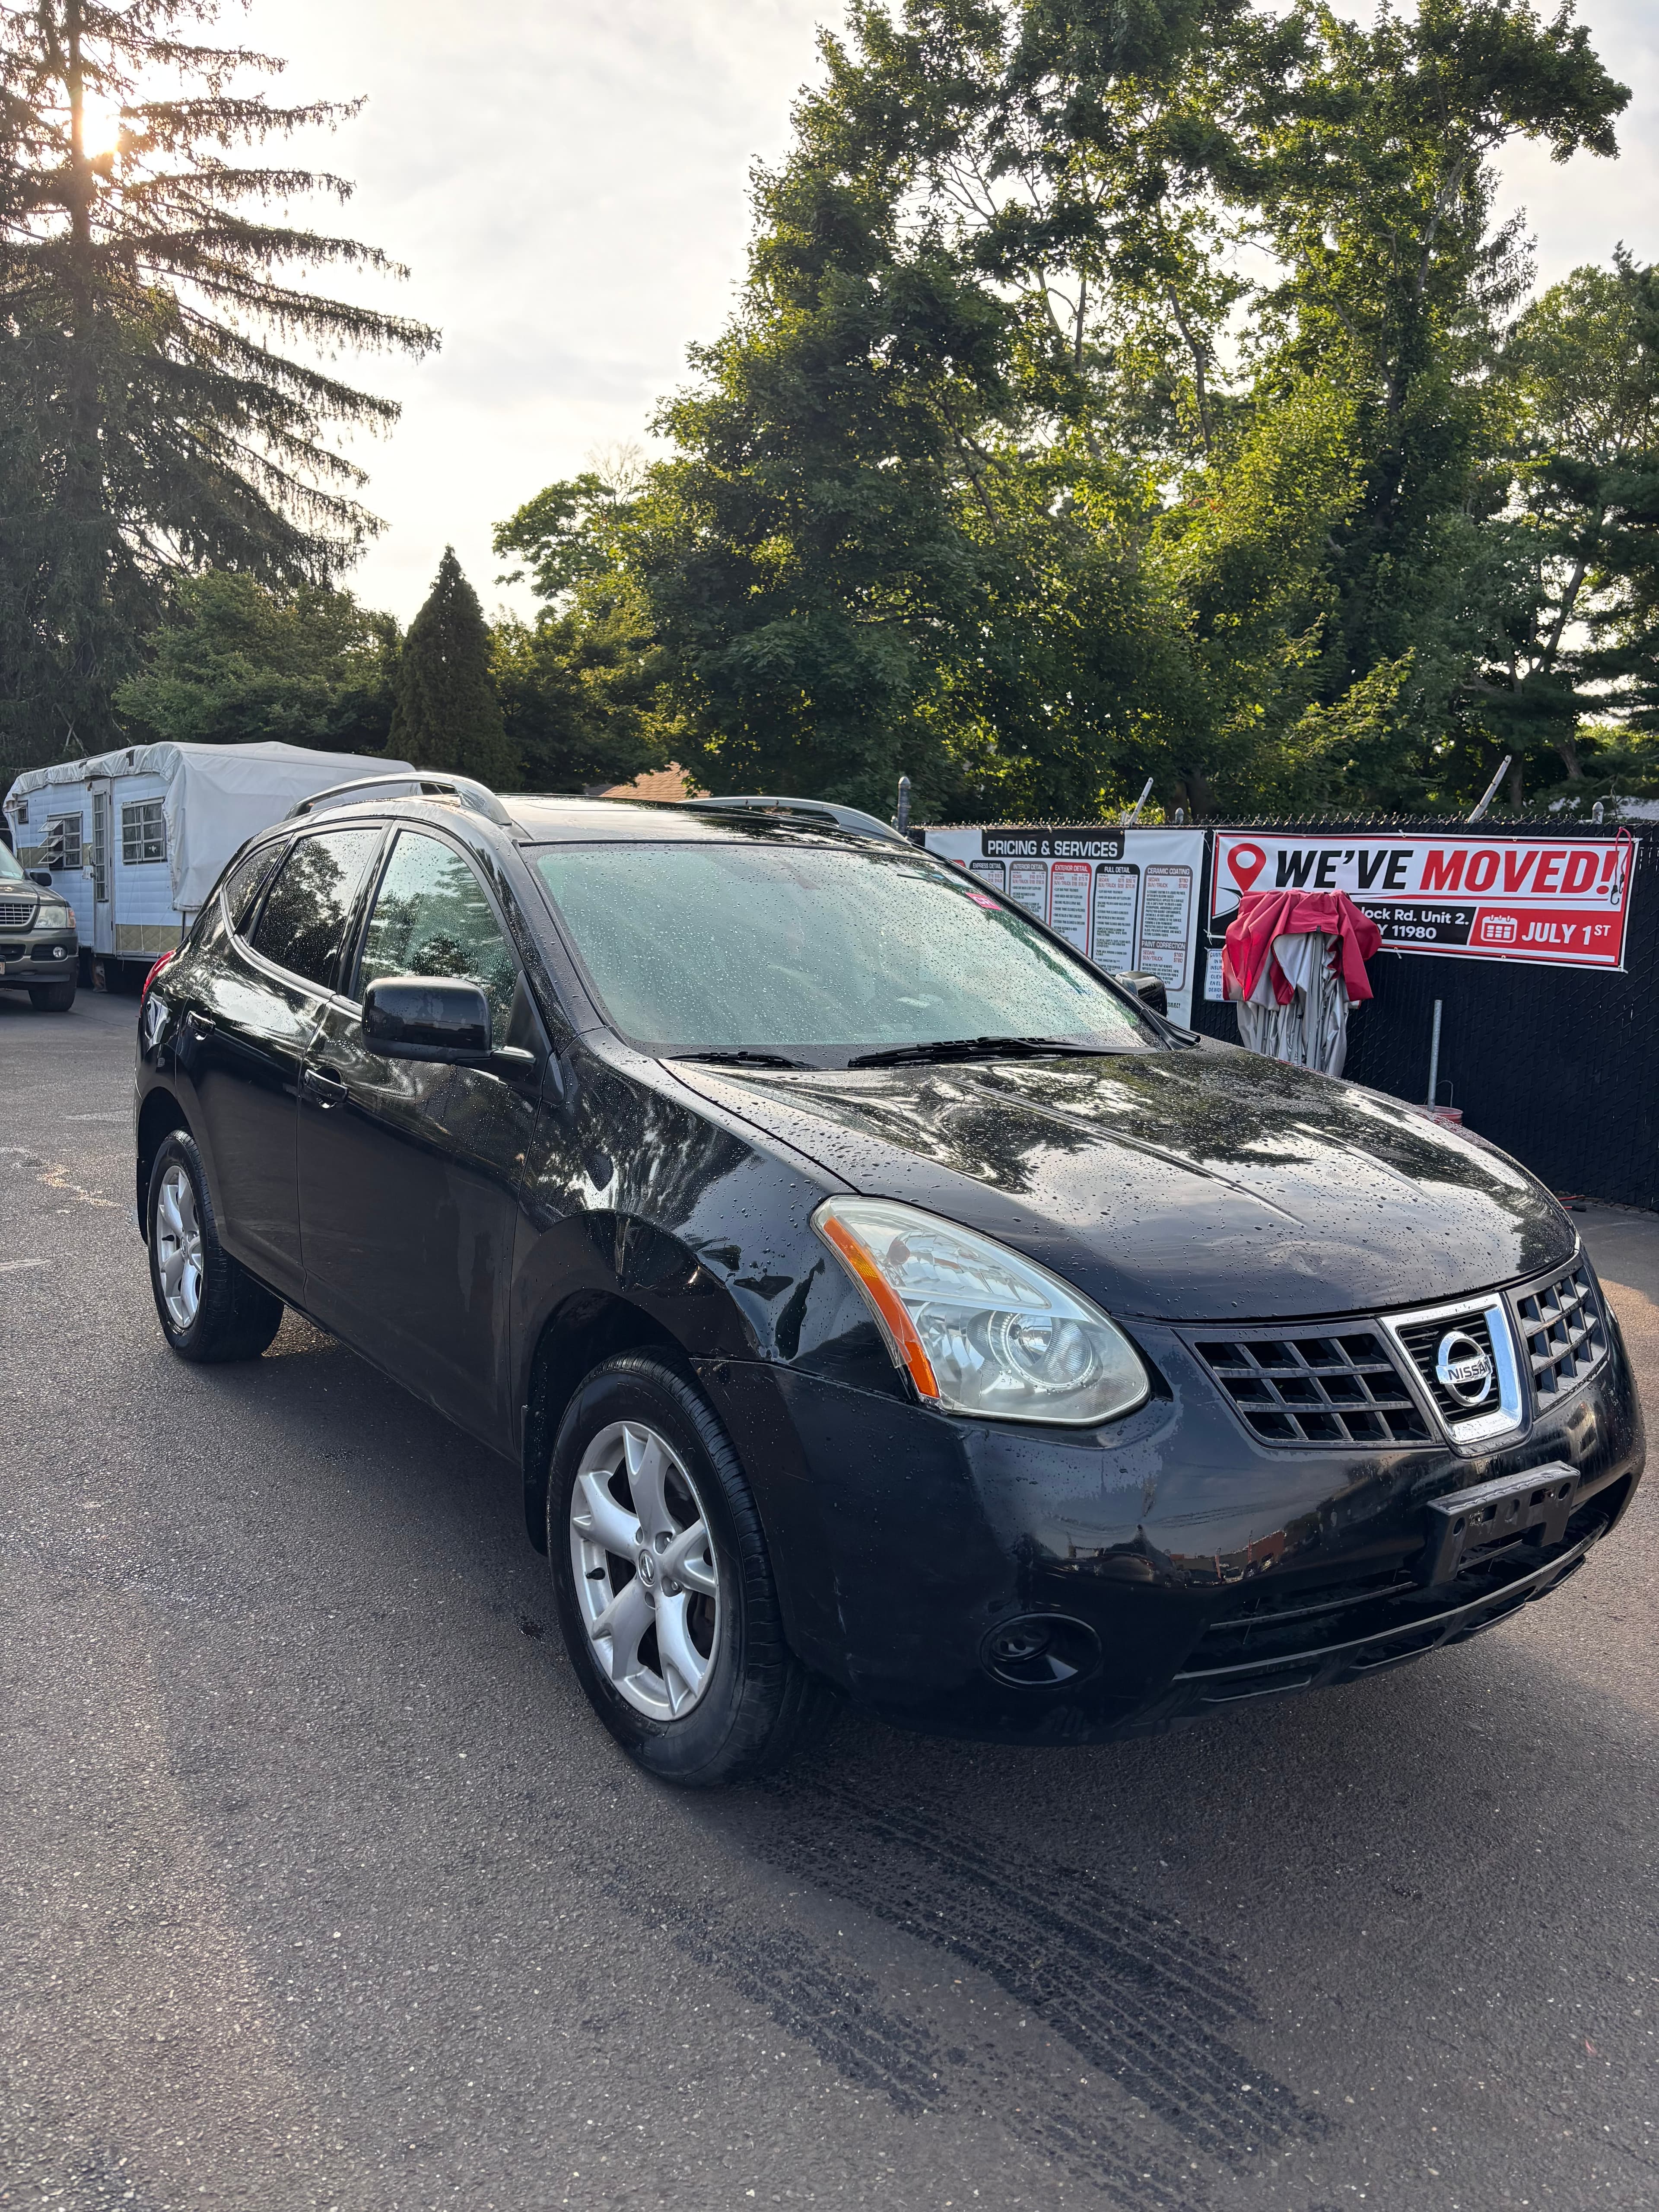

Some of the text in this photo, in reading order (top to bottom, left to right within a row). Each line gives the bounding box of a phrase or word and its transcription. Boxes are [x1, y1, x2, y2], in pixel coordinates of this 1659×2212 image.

[988, 840, 1118, 857] PRICING & SERVICES
[1419, 850, 1620, 895] MOVED!
[1394, 909, 1417, 922] Rd.
[1421, 910, 1452, 924] Unit
[1392, 925, 1437, 939] 11980
[1522, 922, 1577, 944] JULY
[1447, 1358, 1491, 1380] NISSAN
